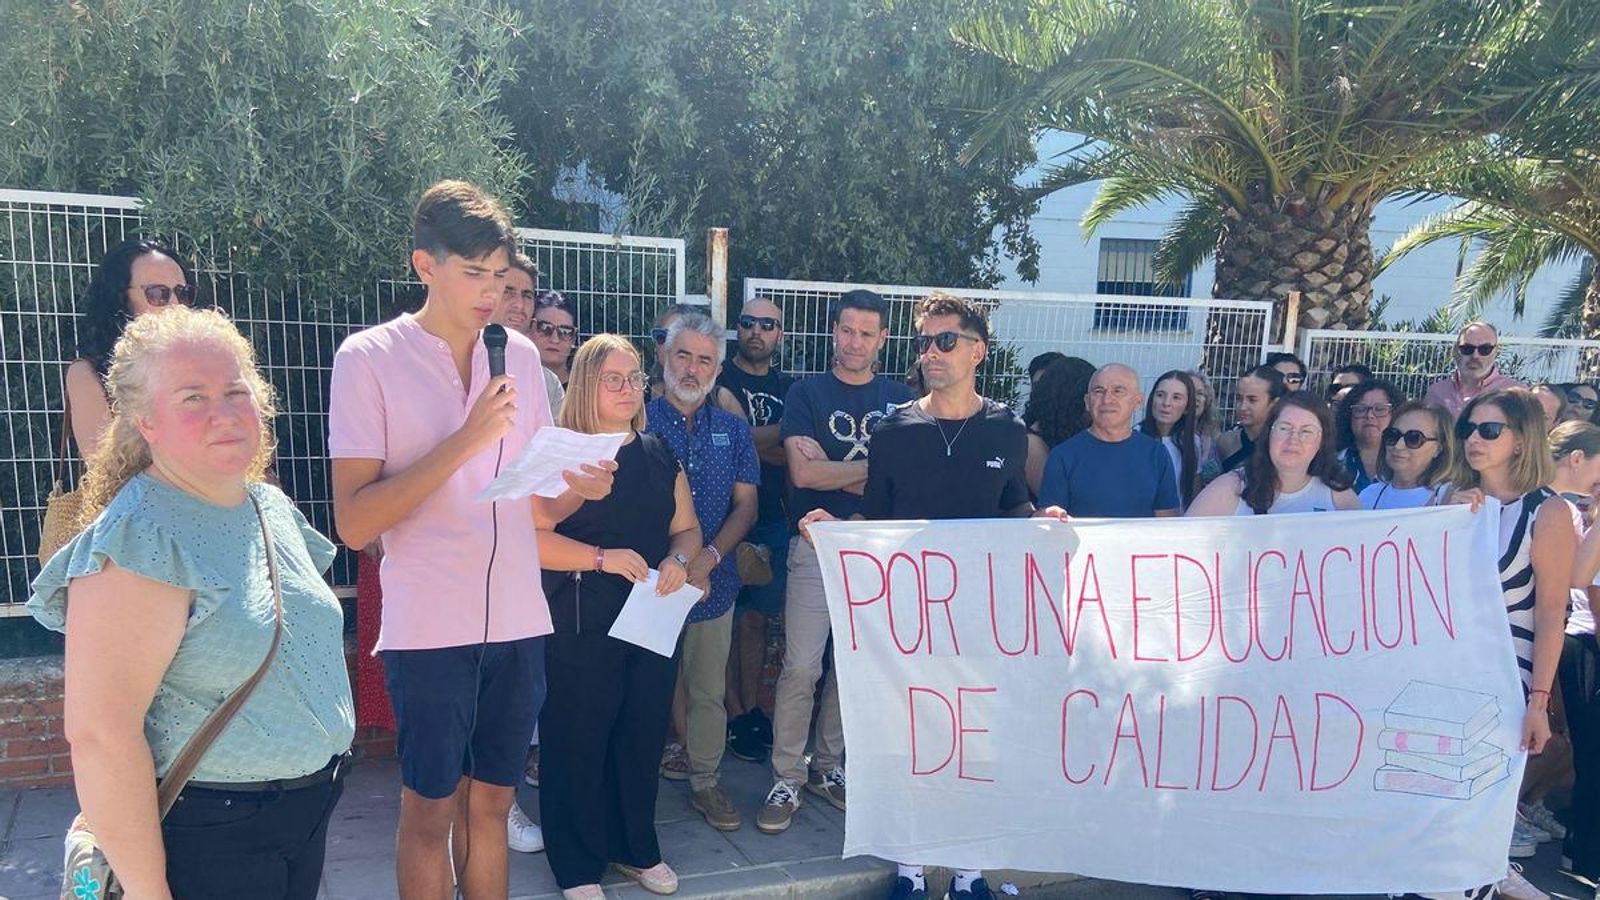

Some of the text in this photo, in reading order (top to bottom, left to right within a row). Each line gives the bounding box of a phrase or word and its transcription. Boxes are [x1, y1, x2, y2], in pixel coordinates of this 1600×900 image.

[838, 525, 1455, 662] POR UNA EDUCACIÓN
[908, 687, 1365, 792] DE CALIDAD
